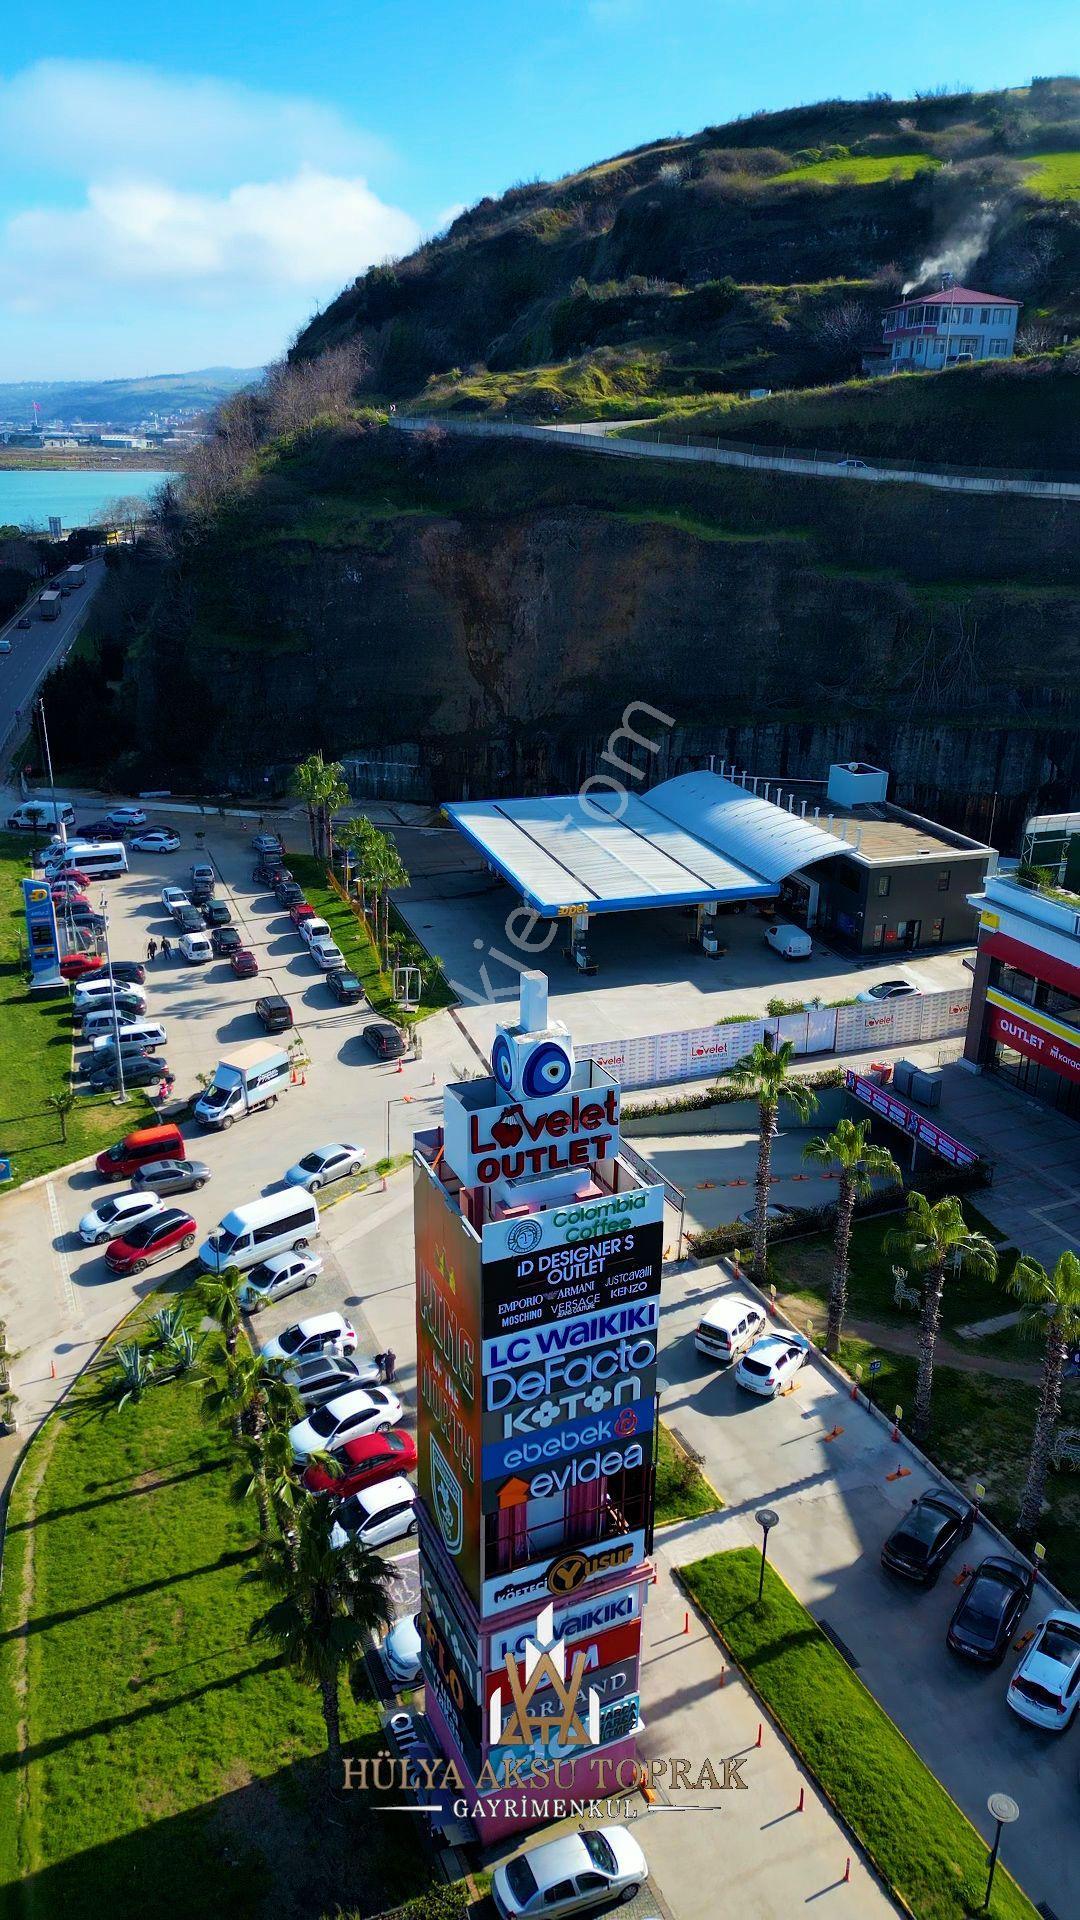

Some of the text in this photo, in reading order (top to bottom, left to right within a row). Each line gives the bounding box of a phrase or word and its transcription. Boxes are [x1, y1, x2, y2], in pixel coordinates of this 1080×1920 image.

[865, 1014, 894, 1027] Lovelet
[1000, 1020, 1045, 1050] OUTLET
[691, 1042, 728, 1057] Lovelet
[1058, 1052, 1080, 1070] karac
[470, 1089, 619, 1155] Lovelet
[476, 1134, 612, 1184] OUTLET
[553, 1192, 646, 1228] Colombia
[566, 1215, 633, 1244] Coffee
[547, 1257, 606, 1285] OUTLET
[498, 1280, 595, 1316] EMPORIO ARMANI
[550, 1293, 601, 1314] VERSACE
[610, 1281, 648, 1299] KENZO
[501, 1308, 543, 1328] MOSCHINO
[490, 1336, 530, 1369] LC
[487, 1339, 656, 1412] DeFacto
[503, 1418, 612, 1470] ebebek
[529, 1444, 643, 1498] evidea
